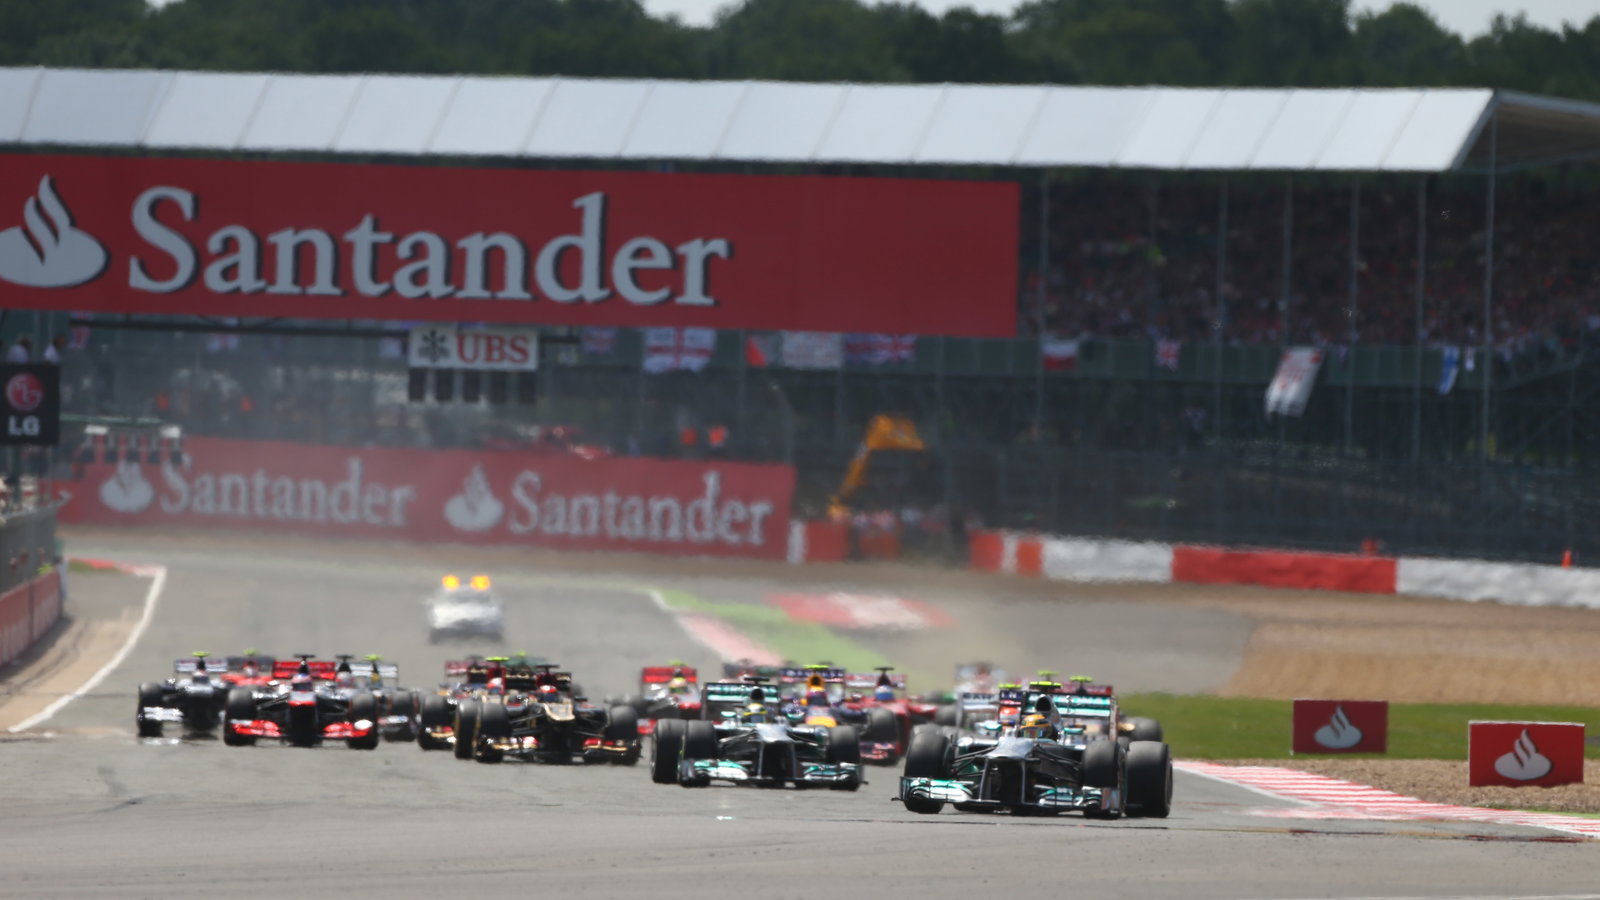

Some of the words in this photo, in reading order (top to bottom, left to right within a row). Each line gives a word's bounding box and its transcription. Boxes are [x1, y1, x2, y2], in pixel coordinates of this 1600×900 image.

[128, 185, 731, 307] Santander
[456, 332, 530, 365] UBS
[8, 415, 41, 437] LG
[160, 452, 415, 527] Santander
[508, 468, 773, 545] Santander
